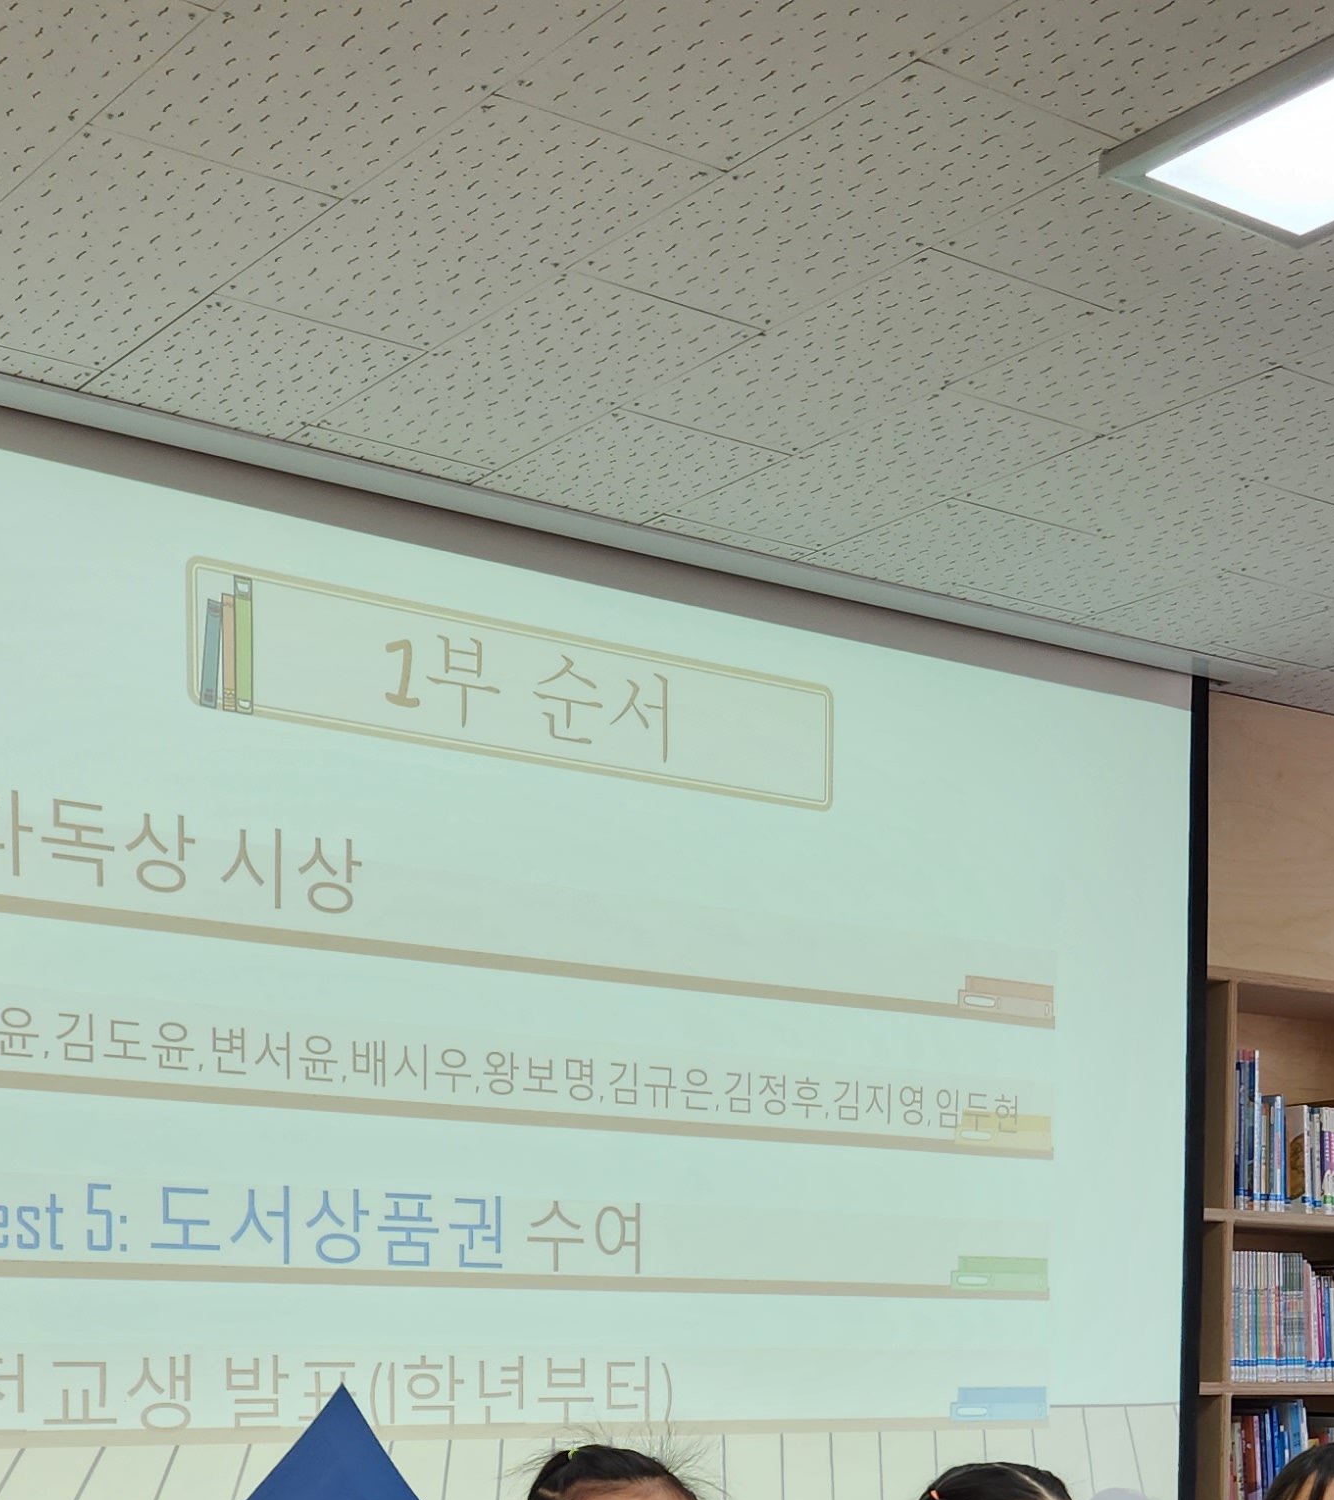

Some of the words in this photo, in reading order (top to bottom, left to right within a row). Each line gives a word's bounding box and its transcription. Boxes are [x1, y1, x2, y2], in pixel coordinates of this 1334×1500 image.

[385, 635, 500, 728] 1부
[533, 654, 668, 763] 순서
[220, 828, 362, 914] 시상
[86, 1182, 128, 1253] 5:
[150, 1185, 503, 1269] 도서상품권
[525, 1199, 642, 1274] 수여
